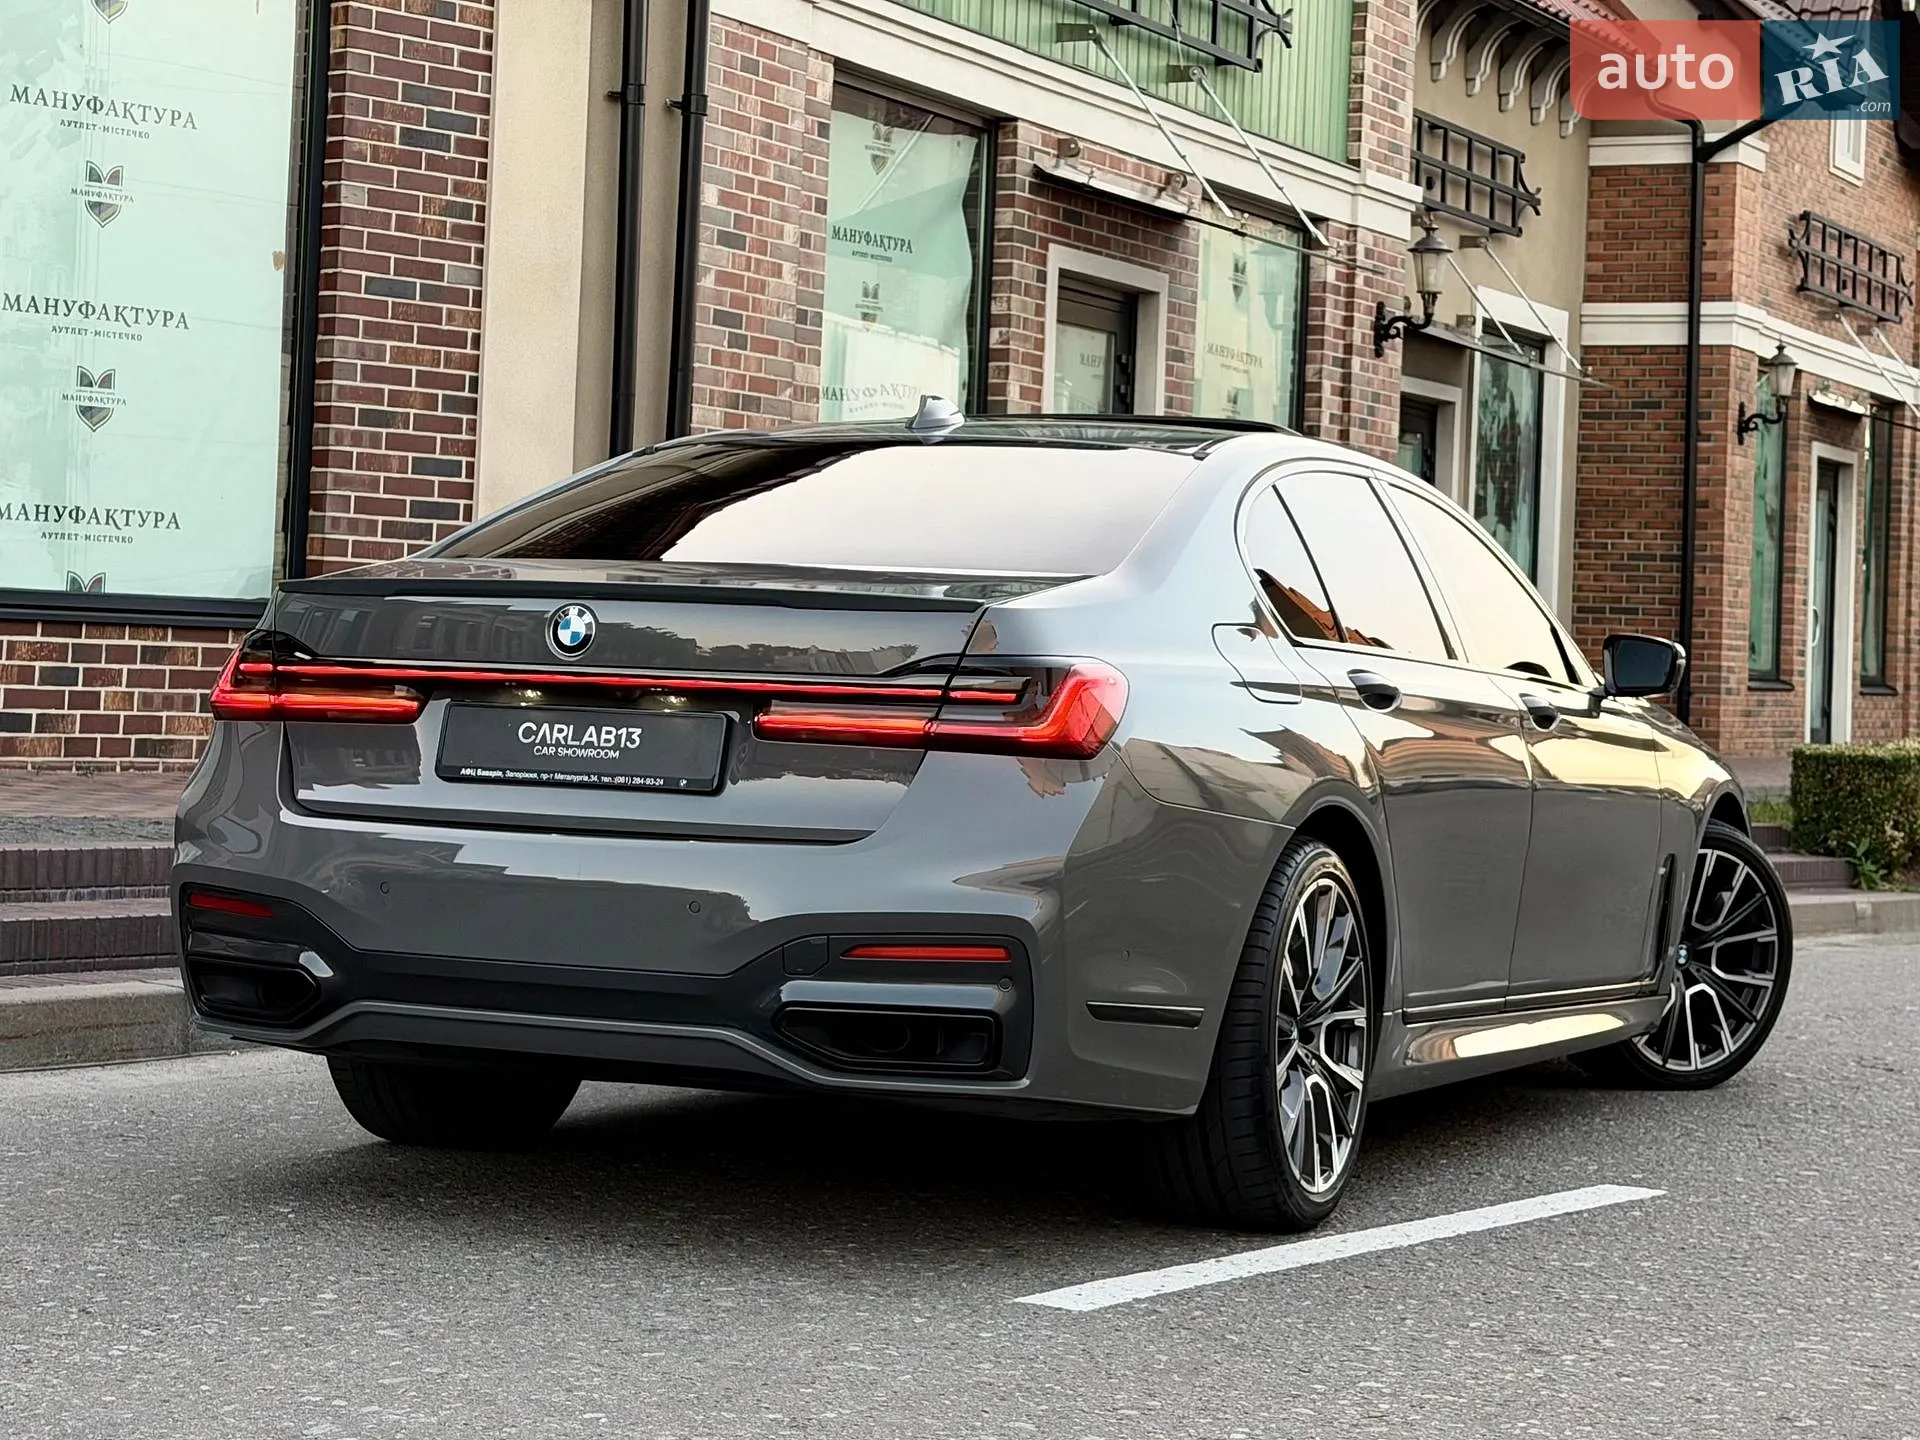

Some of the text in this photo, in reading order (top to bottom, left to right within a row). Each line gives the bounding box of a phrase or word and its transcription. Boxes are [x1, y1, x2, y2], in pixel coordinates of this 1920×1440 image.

[10, 84, 198, 130] МАНУФАКТУРА
[71, 187, 134, 203] МАНУФАКТУРА
[831, 225, 913, 254] МАНУФАКТУРА
[1, 292, 190, 330] МАНУФАКТУРА
[62, 393, 127, 406] МАНУФАКТУРА
[518, 721, 642, 749] CARLAB13
[533, 745, 620, 760] CAR SHOWROOM
